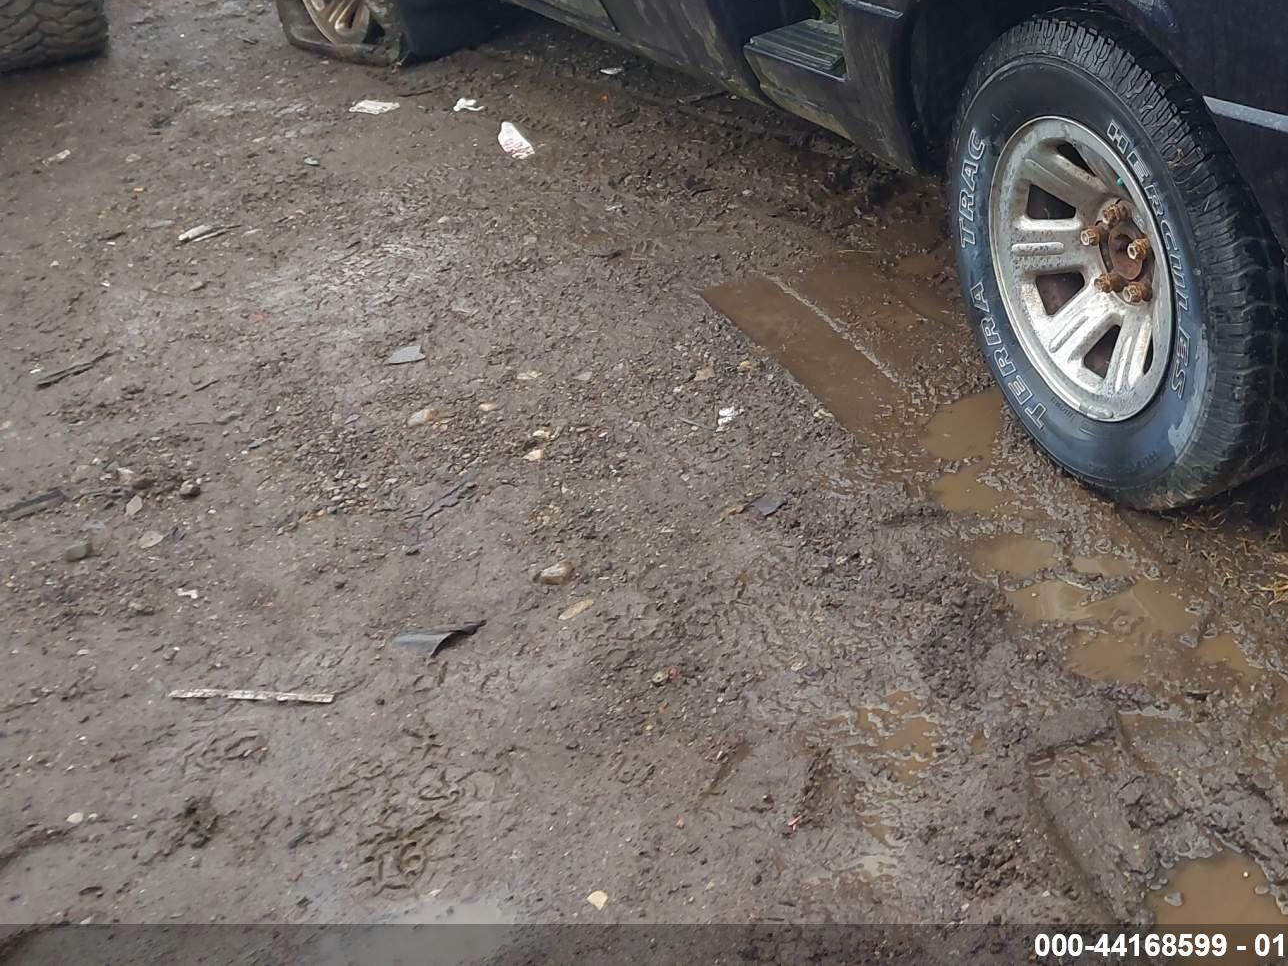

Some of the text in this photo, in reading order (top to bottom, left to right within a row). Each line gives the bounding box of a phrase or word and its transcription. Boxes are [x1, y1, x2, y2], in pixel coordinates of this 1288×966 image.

[957, 128, 1048, 431] TERRA TRAC
[1106, 119, 1191, 401] HERCULES
